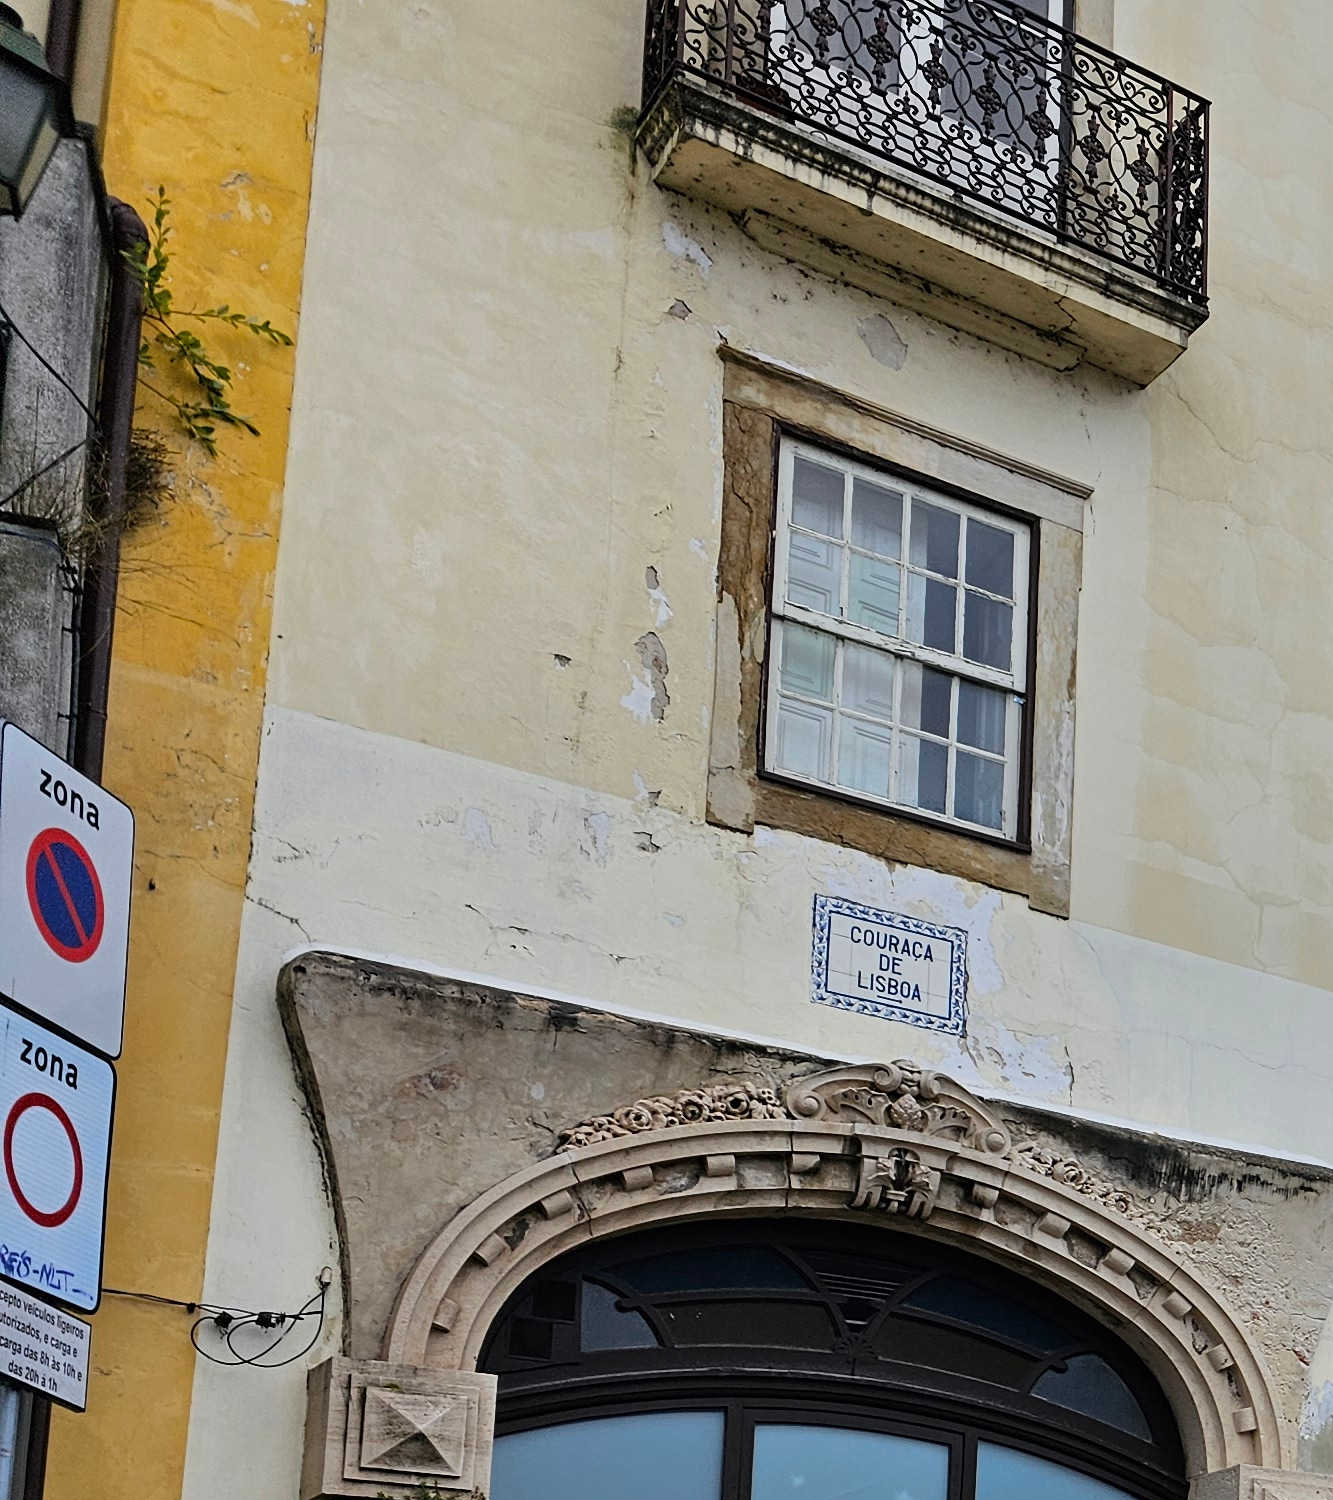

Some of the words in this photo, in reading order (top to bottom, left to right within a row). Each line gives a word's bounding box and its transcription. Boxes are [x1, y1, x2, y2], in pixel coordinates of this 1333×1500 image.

[40, 768, 99, 831] zona
[851, 926, 933, 962] COURAÇA
[879, 953, 903, 975] DE
[858, 971, 921, 1002] LISBOA
[20, 1038, 78, 1090] zona
[23, 1300, 55, 1325] veículos
[57, 1314, 84, 1340] ligeiros
[24, 1344, 38, 1361] das
[63, 1362, 76, 1380] 10h
[51, 1336, 71, 1357] carga
[8, 1360, 23, 1377] das
[25, 1367, 39, 1383] 20h
[49, 1378, 57, 1392] 1h
